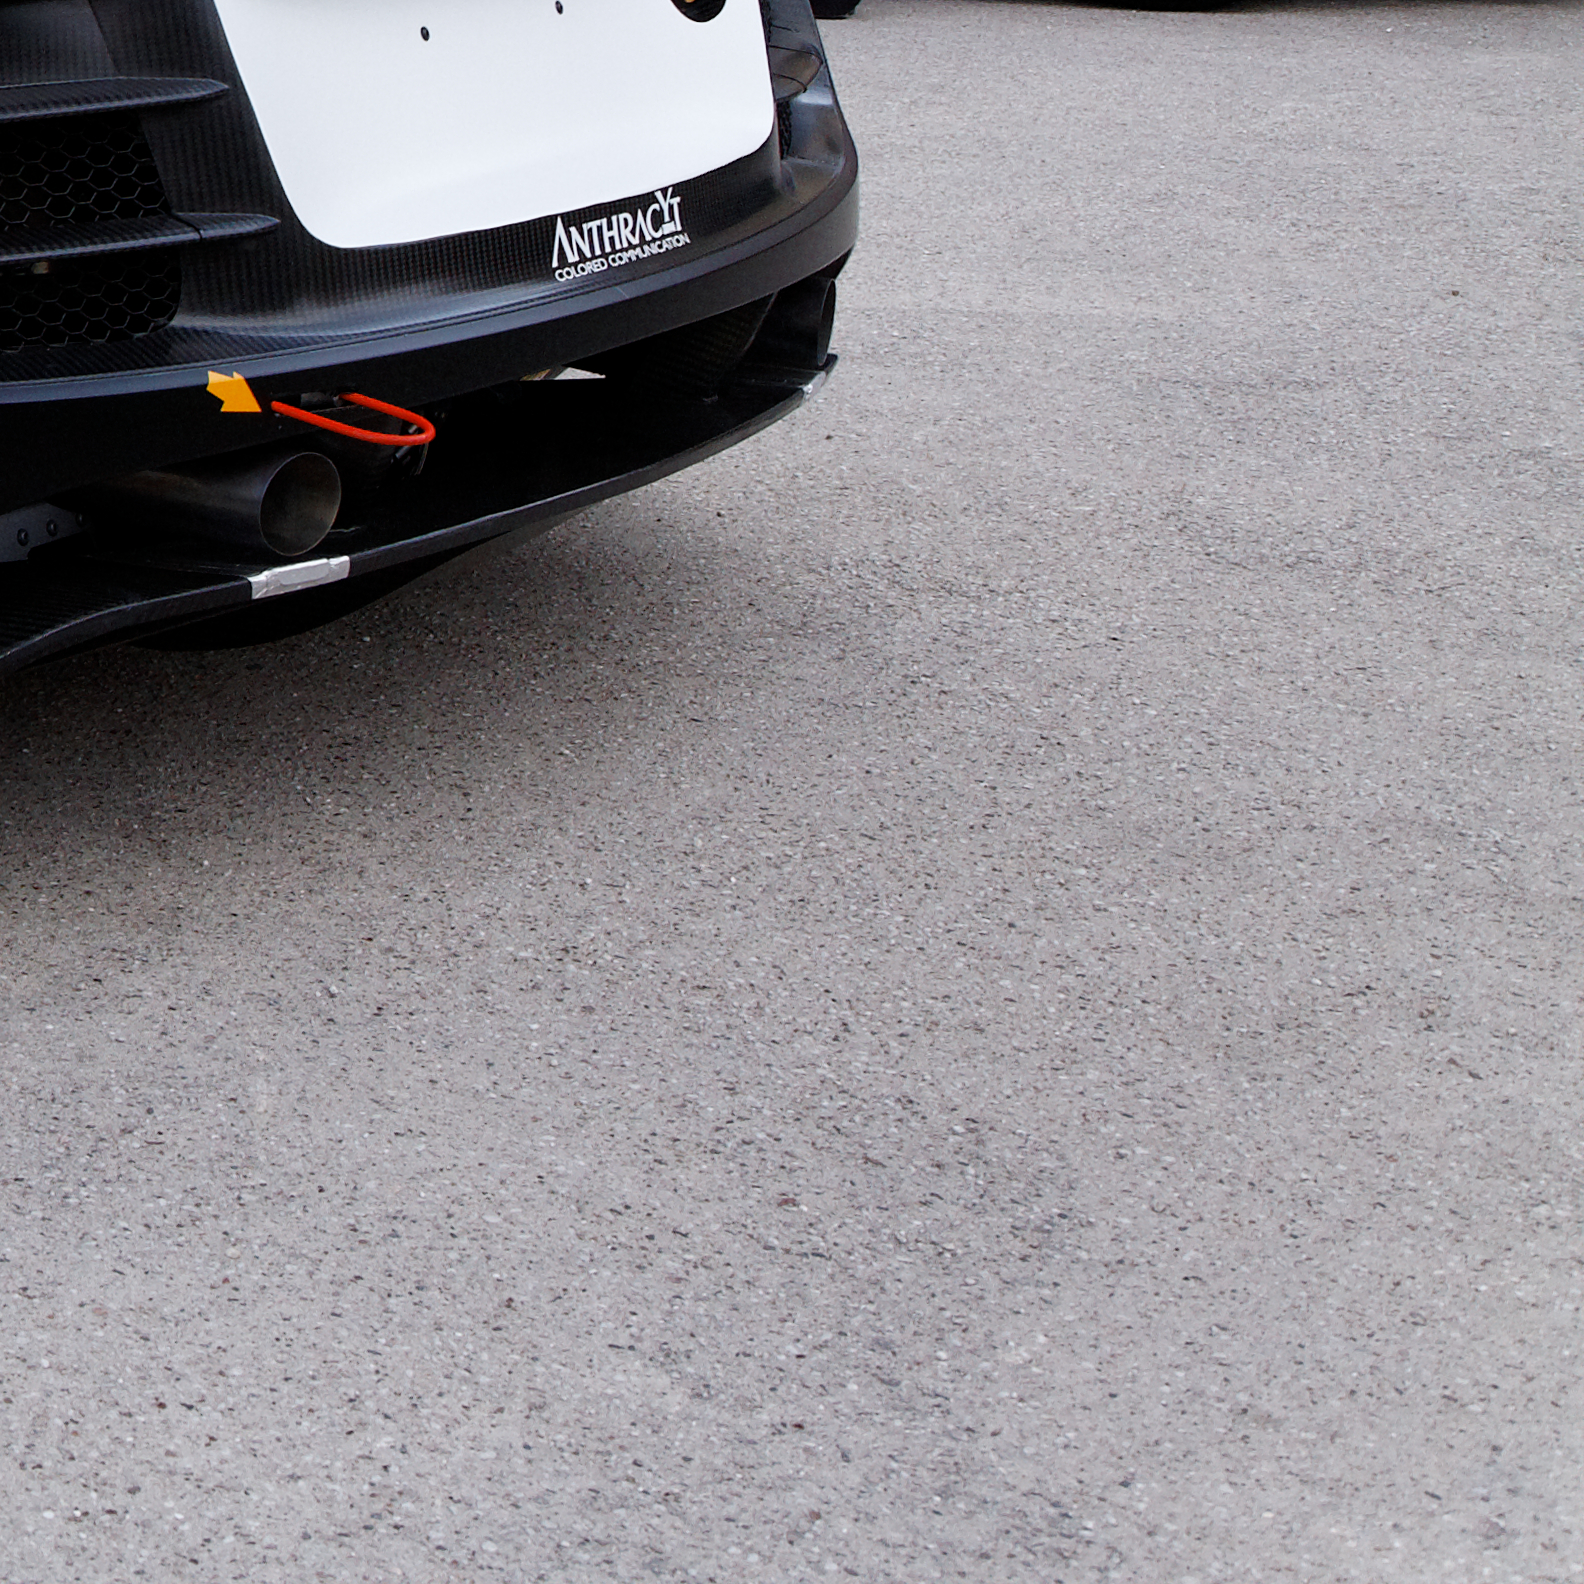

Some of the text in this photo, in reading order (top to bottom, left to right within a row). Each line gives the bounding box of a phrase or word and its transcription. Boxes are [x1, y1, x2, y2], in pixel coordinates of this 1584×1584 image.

[551, 187, 682, 268] ANTHRACYT
[554, 232, 691, 282] COLORED COMMUNICATION
